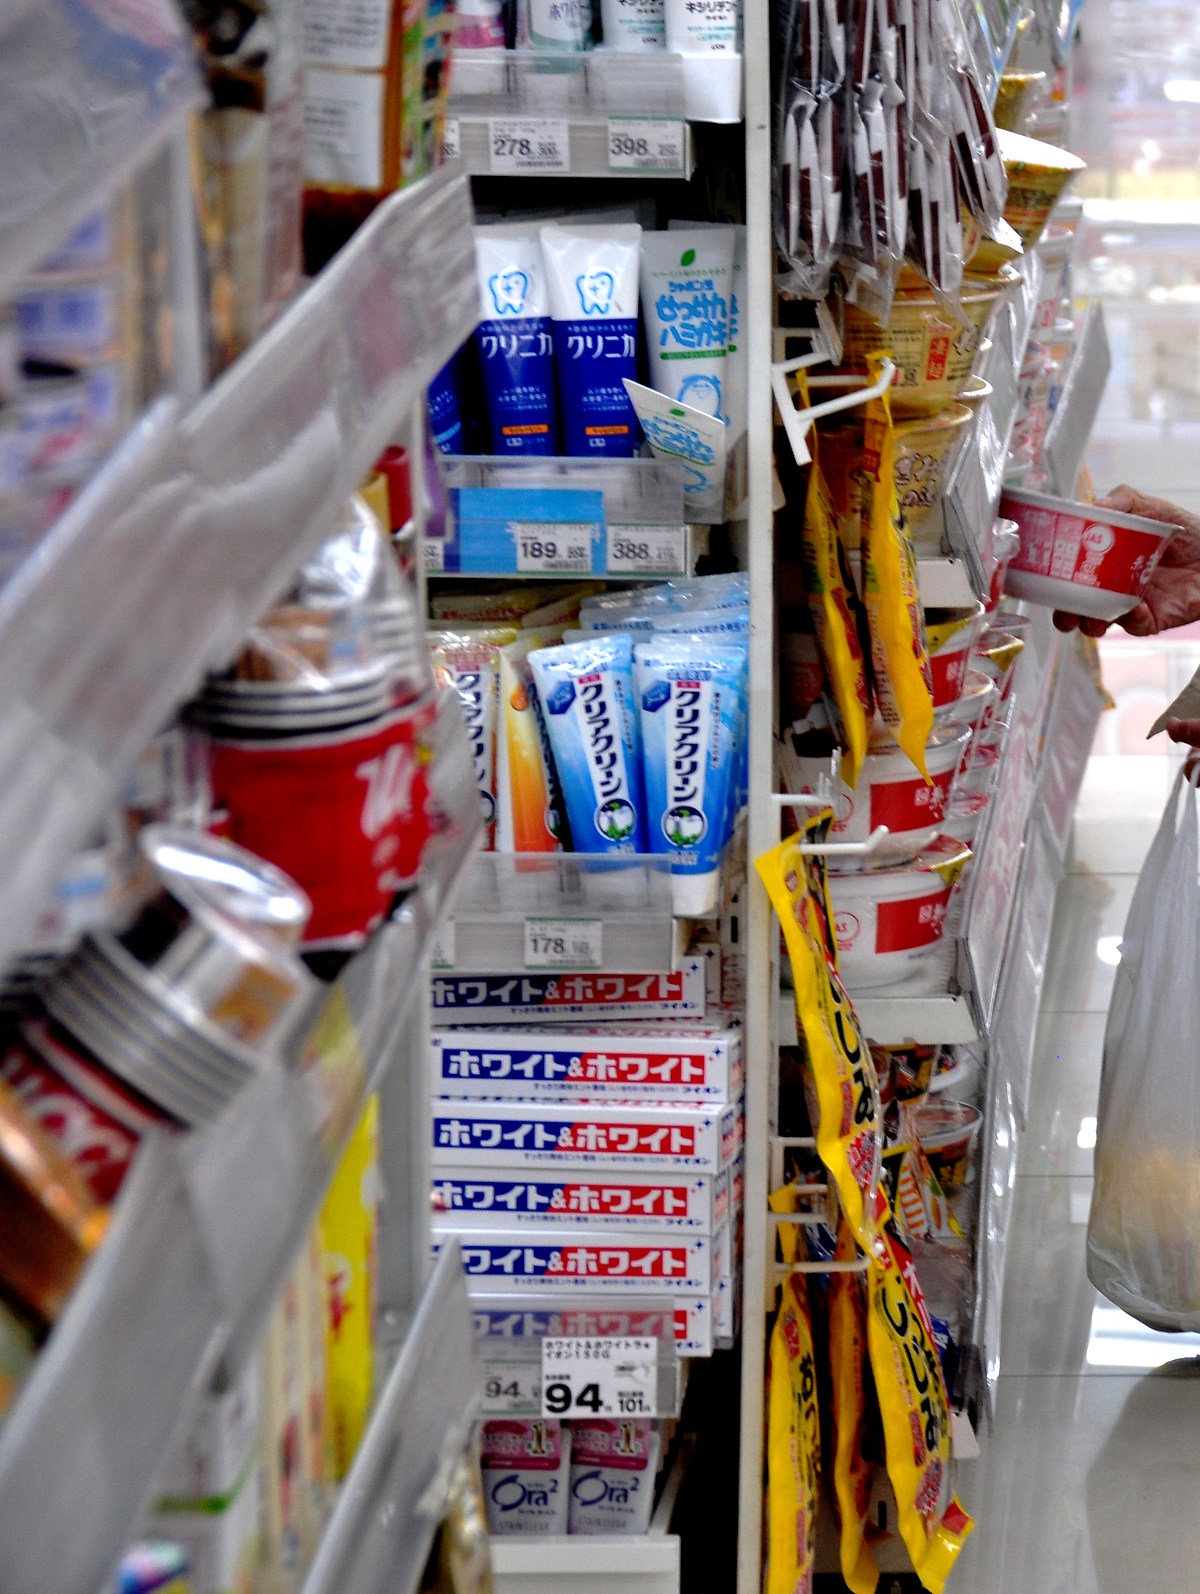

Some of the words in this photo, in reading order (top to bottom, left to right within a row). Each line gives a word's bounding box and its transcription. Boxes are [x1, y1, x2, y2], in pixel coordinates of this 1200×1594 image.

[494, 138, 530, 156] 278
[611, 138, 648, 156] 398
[481, 332, 553, 359] クリニカ
[567, 333, 635, 359] クリニカ
[660, 320, 727, 348] ハミガキ
[521, 542, 557, 559] 189
[612, 543, 649, 560] 388
[580, 684, 621, 797] クリアクリーン
[674, 691, 700, 802] クリアクリーン
[531, 938, 564, 954] 178
[433, 975, 681, 1006] ホワイト&ホワイト
[449, 1050, 704, 1081] ホワイト&ホワイト
[439, 1120, 694, 1151] ホワイト&ホワイト
[435, 1181, 687, 1214] ホワイト&ホワイト
[463, 1248, 686, 1275] ワイト&ホワイト
[473, 1312, 686, 1338] ワイト&ホワイト
[485, 1381, 520, 1398] 94
[545, 1383, 604, 1413] 94
[619, 1398, 644, 1412] 101
